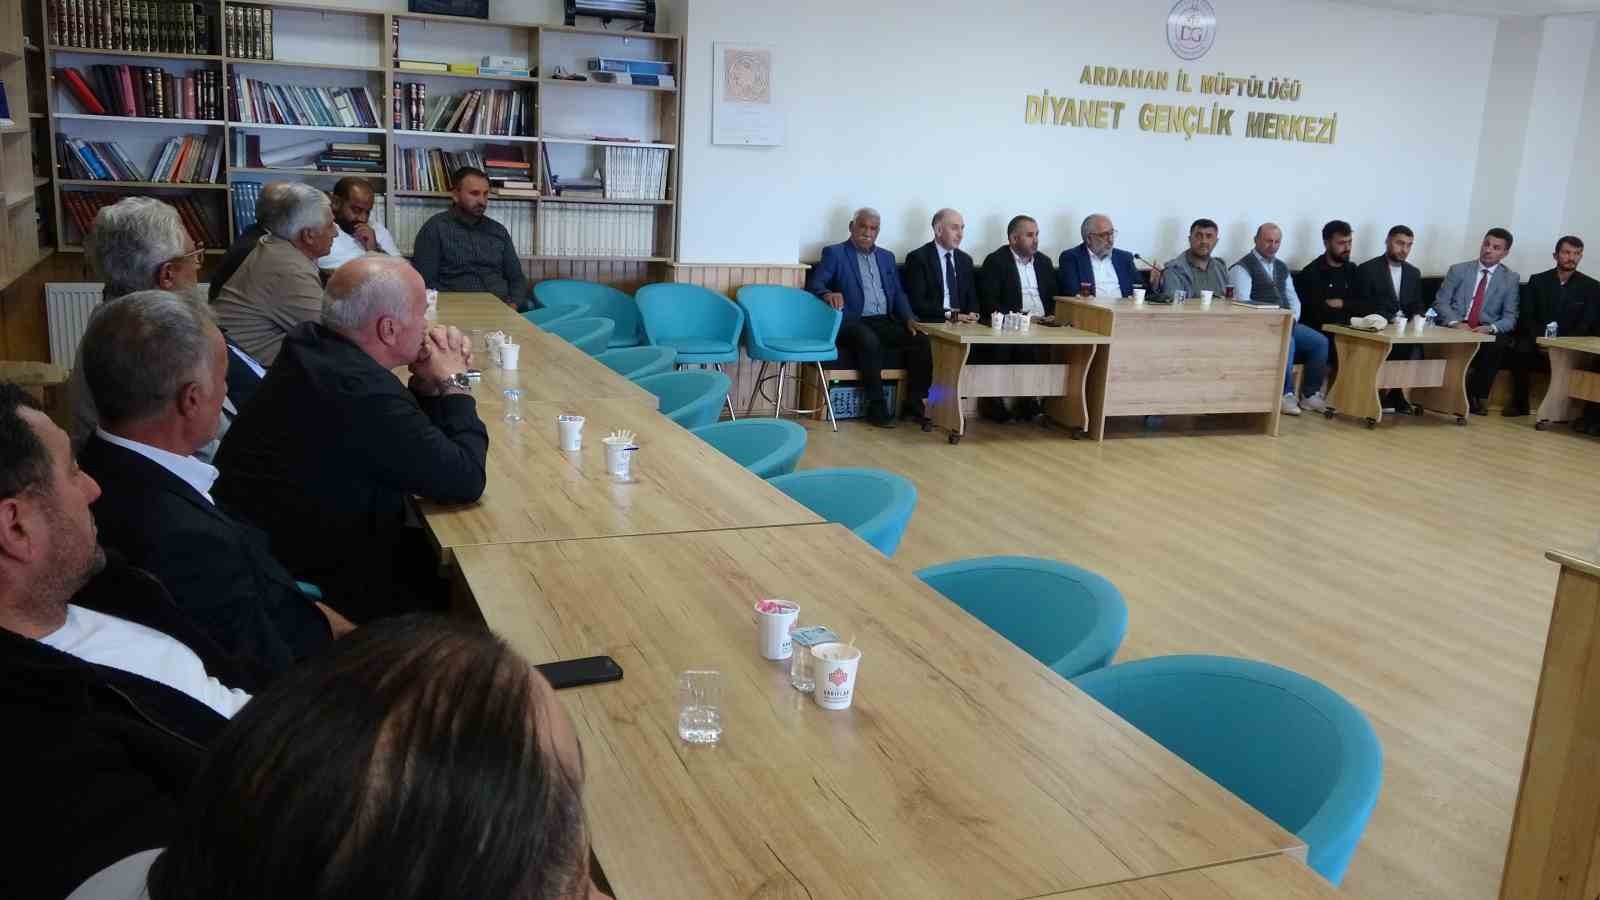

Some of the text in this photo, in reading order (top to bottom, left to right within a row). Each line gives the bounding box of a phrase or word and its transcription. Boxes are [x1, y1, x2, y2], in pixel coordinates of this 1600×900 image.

[1080, 65, 1301, 101] ARDAHAN İL MÜFTÜLÜĞÜ
[1025, 89, 1337, 144] DİYANET GENÇLİK MERKEZİ
